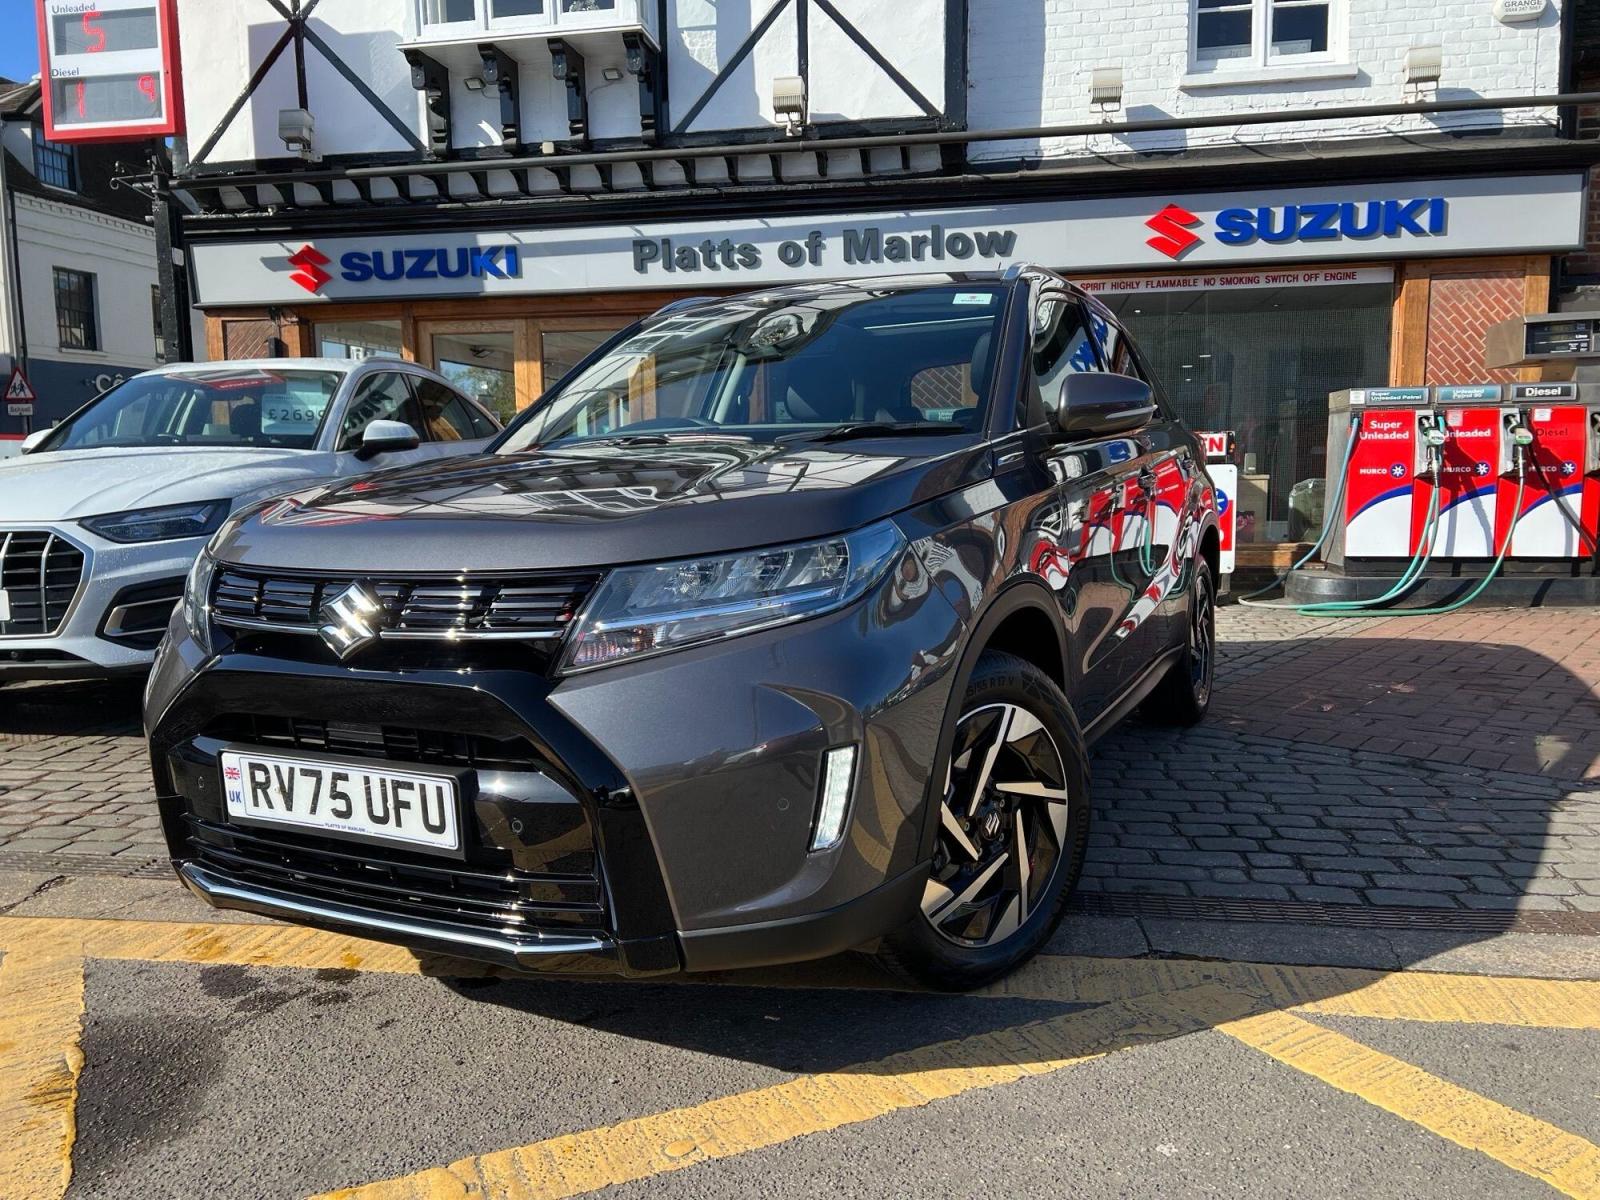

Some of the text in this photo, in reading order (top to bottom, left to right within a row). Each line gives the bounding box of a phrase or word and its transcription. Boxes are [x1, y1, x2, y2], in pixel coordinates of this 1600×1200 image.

[51, 3, 96, 14] Unleaded
[51, 67, 80, 77] Diesel
[1214, 197, 1448, 246] SUZUKI
[632, 224, 1018, 274] Platts of Marlow
[340, 245, 518, 282] SUZUKI
[1080, 271, 1357, 291] SPIRIT HIGHLY FLAMMABLE NO SMOKING SWITCH OFF ENGINE
[1525, 387, 1561, 397] Diesel
[1370, 421, 1402, 430] Super
[1360, 431, 1409, 440] Unleaded
[1536, 428, 1569, 437] Diesel
[229, 790, 242, 803] UK
[248, 761, 446, 835] RV75 UFU
